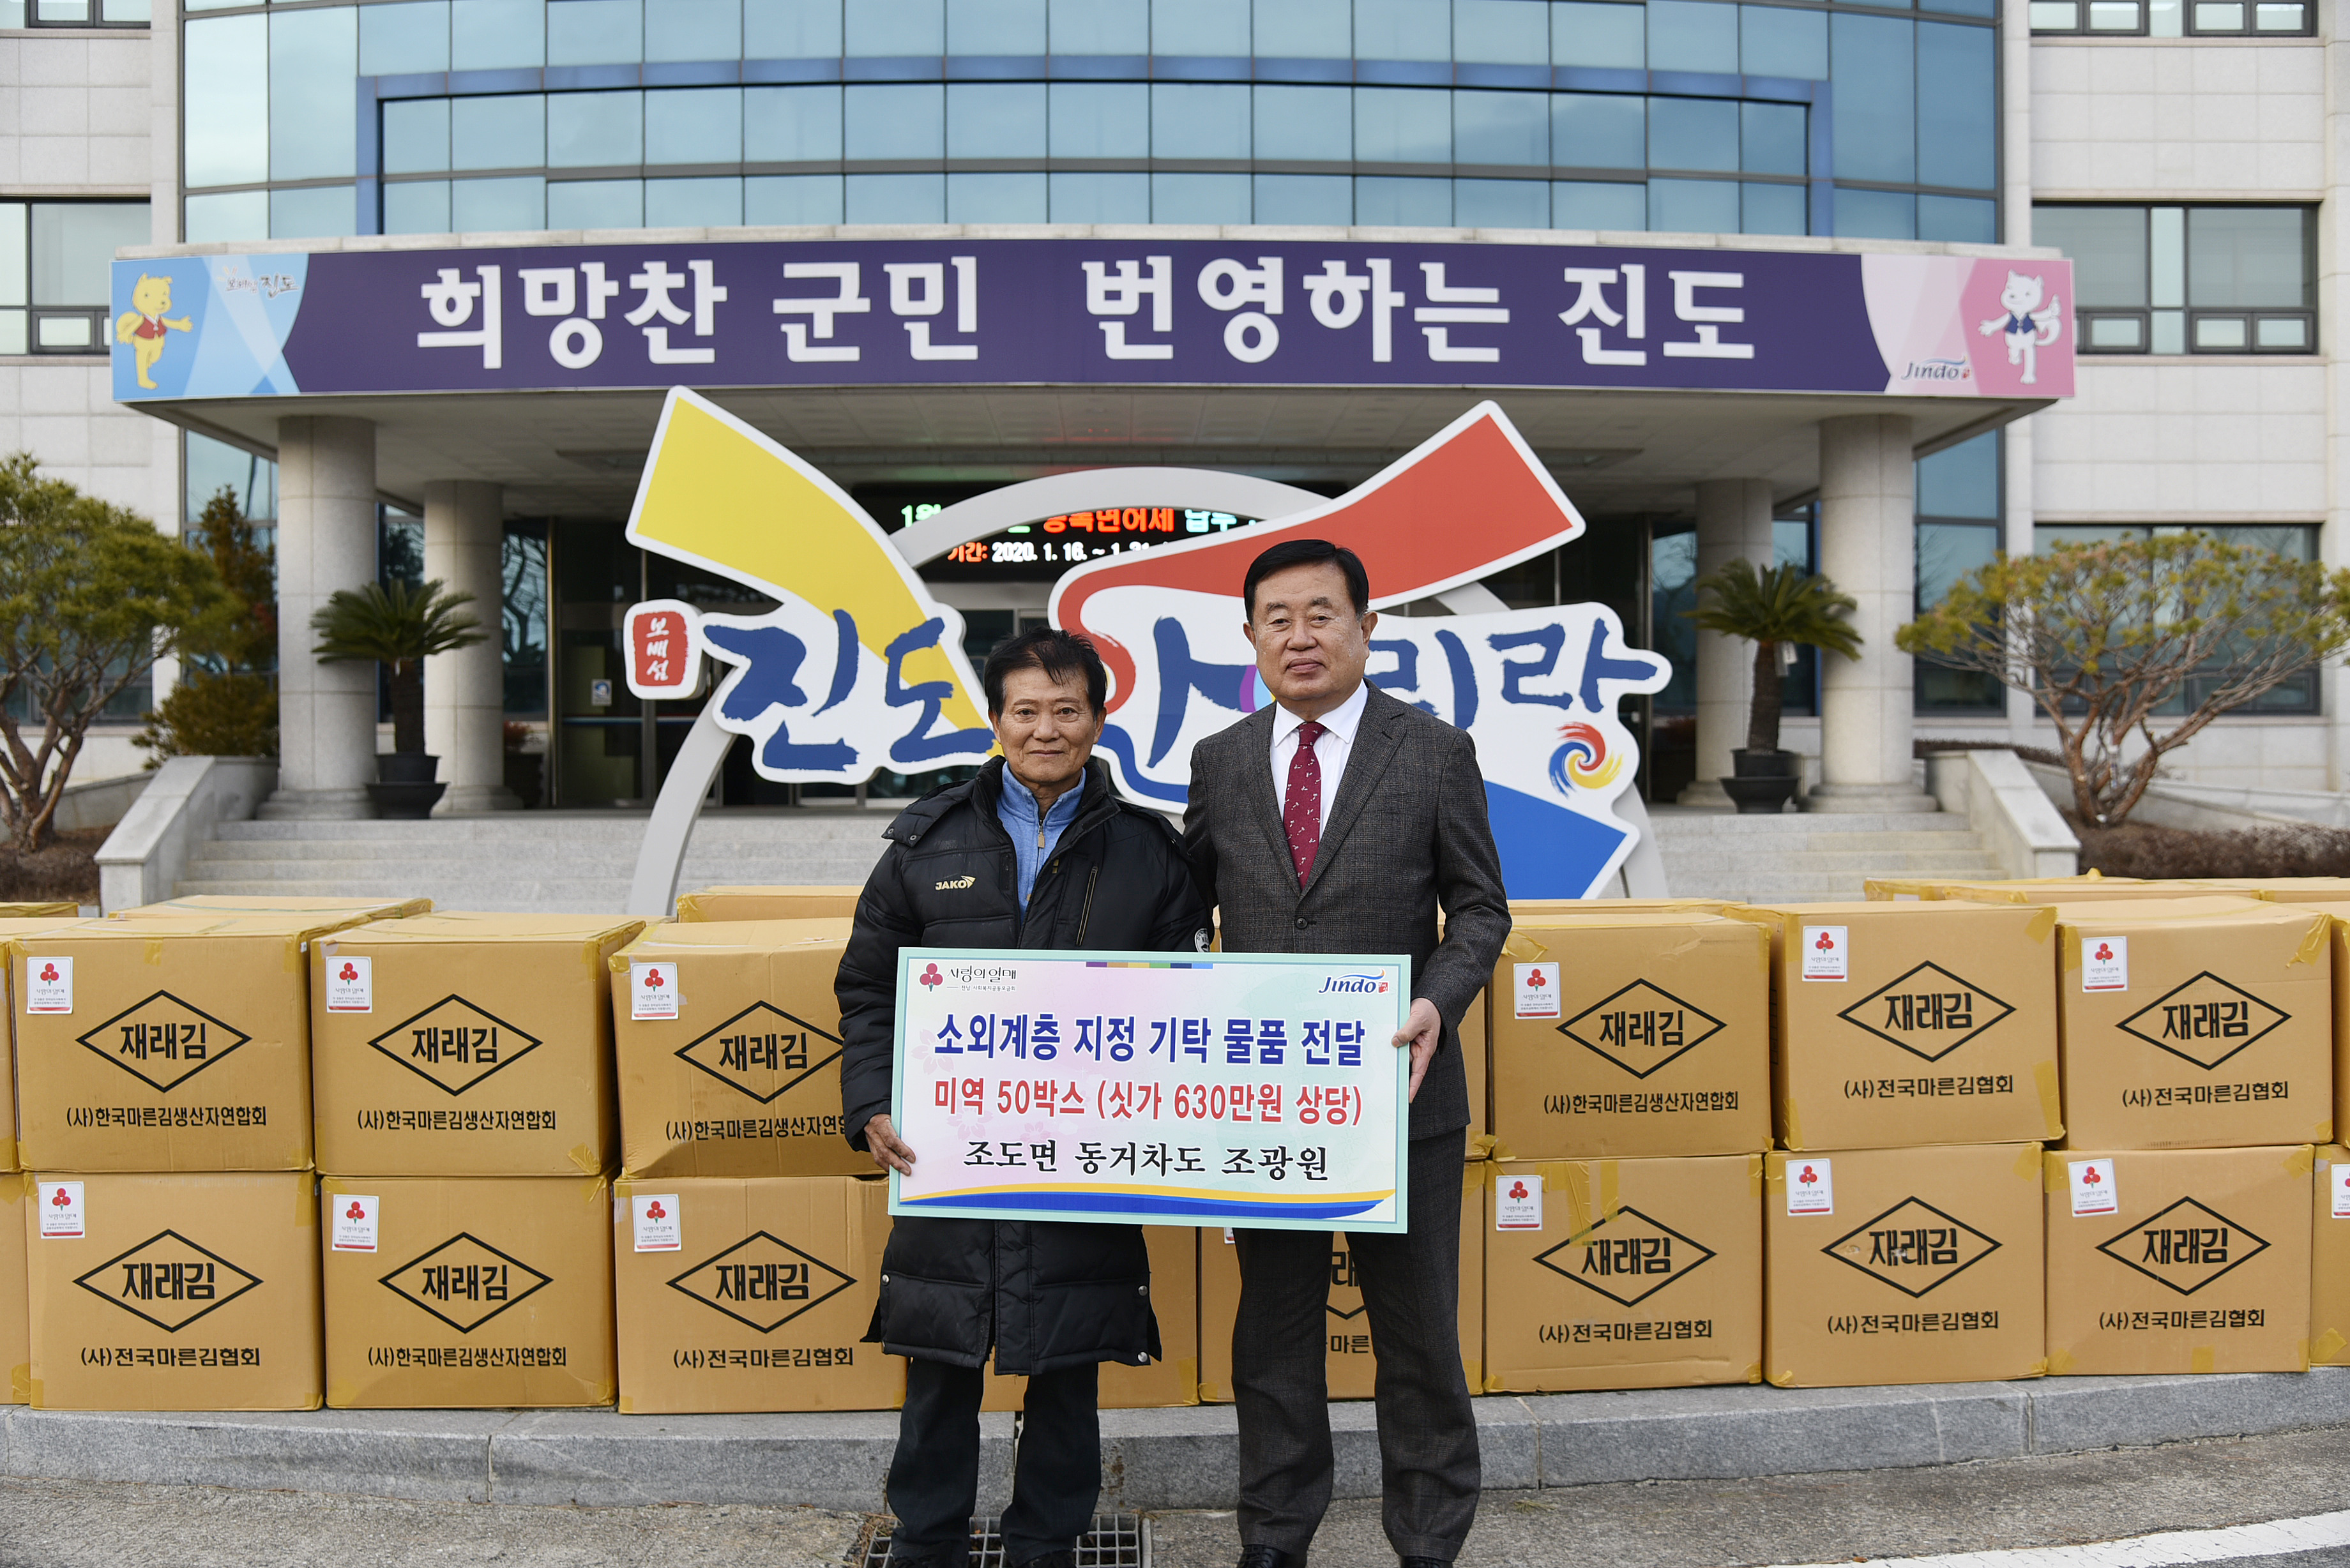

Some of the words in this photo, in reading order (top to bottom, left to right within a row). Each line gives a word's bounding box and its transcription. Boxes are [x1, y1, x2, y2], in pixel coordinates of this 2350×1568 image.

[418, 260, 727, 369] 희망찬
[773, 256, 978, 362] 군민
[1082, 255, 1509, 363] 번영하는
[1559, 263, 1754, 365] 진도
[1901, 361, 1959, 381] Jindo
[992, 542, 1038, 562] 2020.
[1043, 543, 1058, 561] 1.
[1063, 542, 1088, 562] 16.
[646, 617, 669, 681] 보배섬
[704, 609, 994, 773] 진도
[935, 880, 967, 891] JAKO
[1318, 976, 1377, 993] Jindo
[1600, 1011, 1683, 1047] 재래김
[1885, 993, 1971, 1030] 재래김
[2163, 1001, 2248, 1039] 재래김
[120, 1023, 206, 1059] 재래김
[412, 1027, 497, 1063] 재래김
[719, 1033, 807, 1071] 재래김
[935, 1013, 1060, 1060] 소외계층
[1074, 1016, 1135, 1062] 지정
[1149, 1017, 1211, 1063] 기탁
[1224, 1019, 1287, 1064] 물품
[1301, 1020, 1365, 1066] 전달
[936, 1077, 984, 1115] 미역
[998, 1080, 1085, 1117] 50박스
[1098, 1080, 1162, 1120] (싯가
[1174, 1083, 1282, 1122] 630만원
[1296, 1086, 1361, 1126] 상당)
[1543, 1091, 1738, 1115] (사)한국마른김생산자연합회
[1844, 1075, 2013, 1099] (사)전국마른김협회
[2123, 1082, 2288, 1107] (사)전국마른김협회
[67, 1106, 266, 1127] (사)한국마른김생산자연합회
[358, 1110, 556, 1131] (사)한국마른김생산자연합회
[666, 1115, 845, 1140] (사)한국마른김생산자연
[964, 1140, 1058, 1172] 조도면
[1075, 1142, 1206, 1177] 동거차도
[1222, 1145, 1328, 1180] 조광원
[1582, 1237, 1671, 1275] 재래김
[1870, 1228, 1957, 1266] 재래김
[2143, 1228, 2227, 1264] 재래김
[123, 1263, 215, 1299] 재래김
[422, 1265, 507, 1300] 재래김
[716, 1263, 808, 1300] 재래김
[1539, 1320, 1712, 1343] (사)전국마른김협회
[1828, 1311, 1998, 1334] (사)전국마른김협회
[2100, 1309, 2264, 1330] (사)전국마른김협회
[81, 1348, 260, 1367] (사)전국마른김협회
[368, 1346, 566, 1368] (사)한국마른김생산자연합회
[674, 1347, 853, 1369] (사)전국마른김협회
